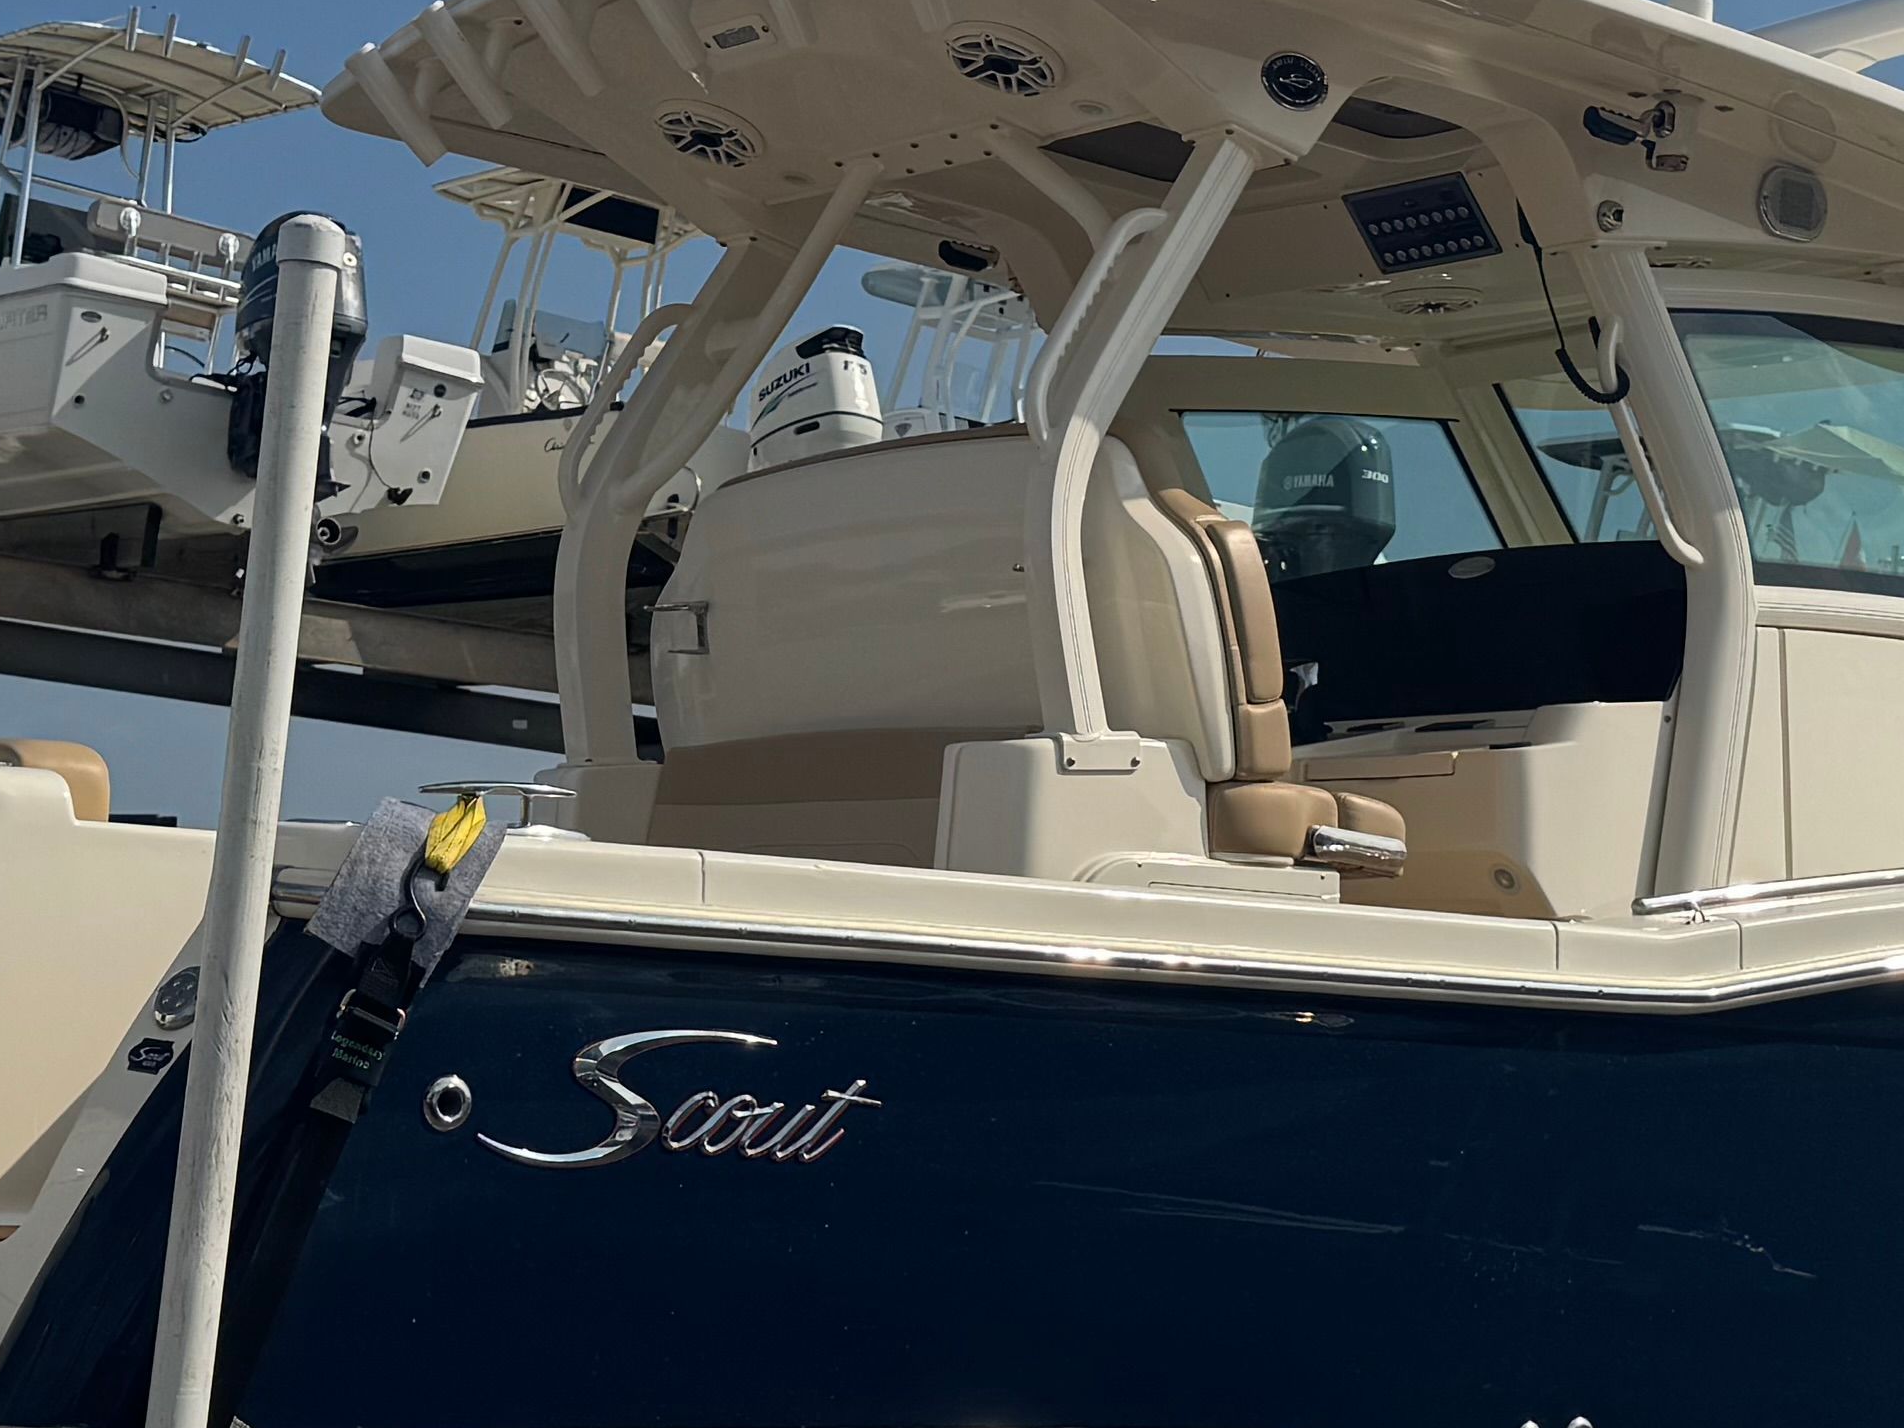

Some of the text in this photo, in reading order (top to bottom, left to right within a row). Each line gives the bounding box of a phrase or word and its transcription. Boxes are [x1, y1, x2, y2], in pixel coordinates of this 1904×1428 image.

[758, 362, 812, 403] SUZUKI
[1293, 473, 1335, 489] YAMAHA
[475, 1028, 883, 1167] Scout
